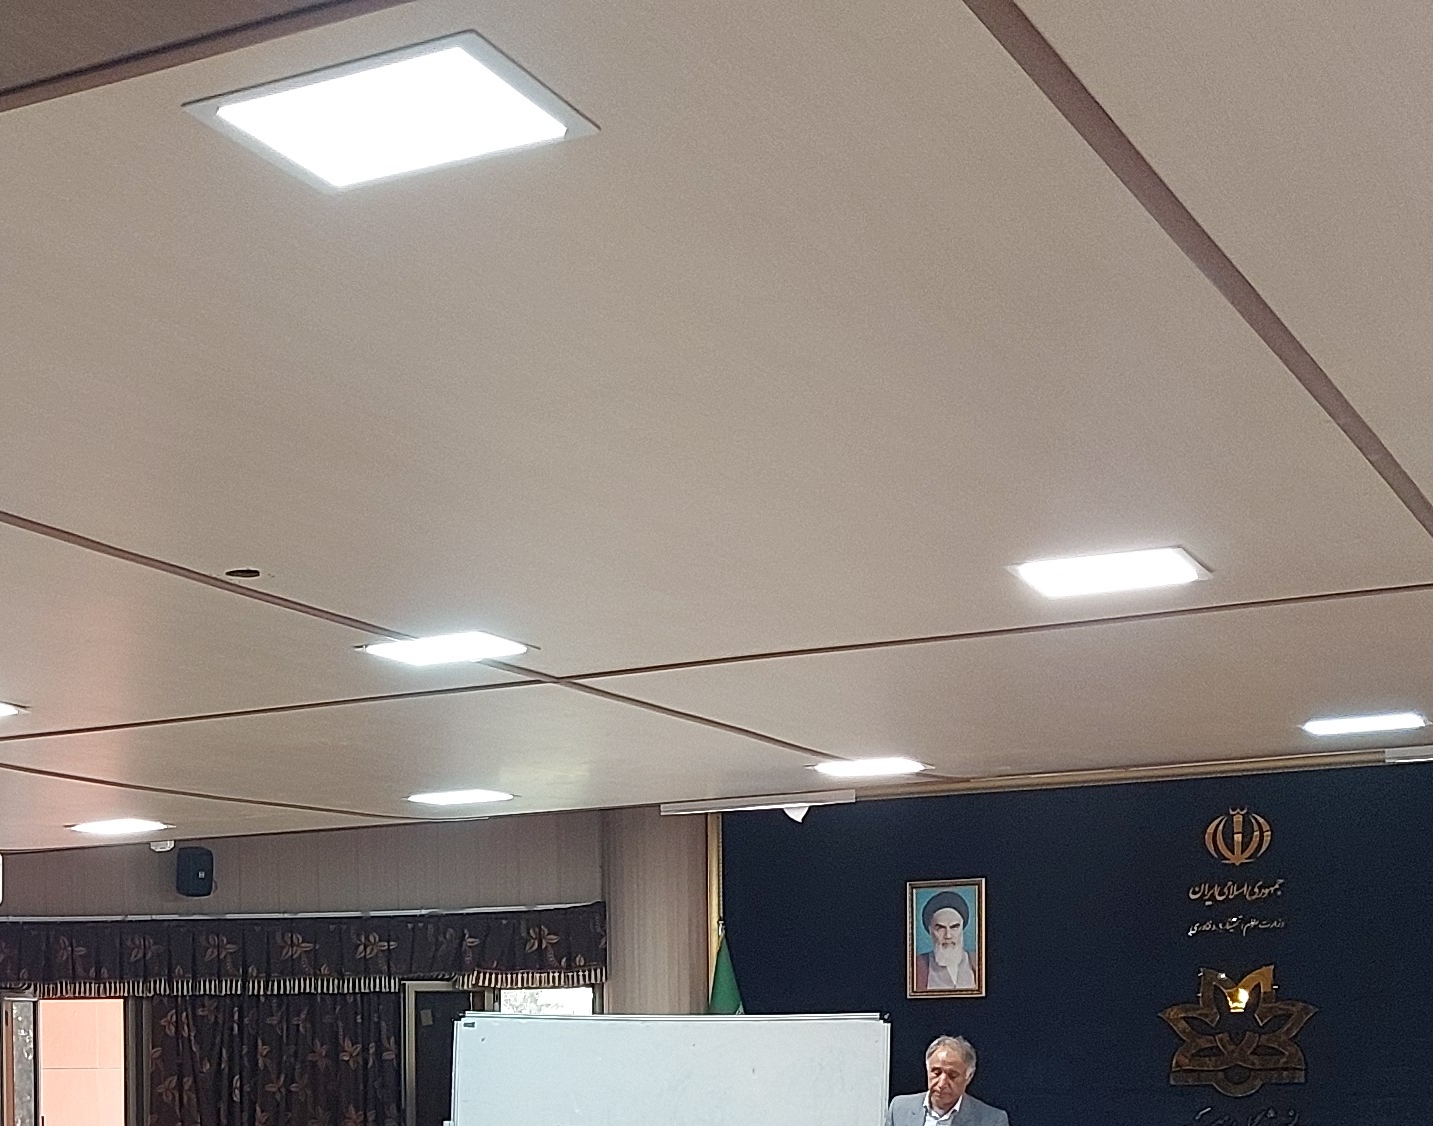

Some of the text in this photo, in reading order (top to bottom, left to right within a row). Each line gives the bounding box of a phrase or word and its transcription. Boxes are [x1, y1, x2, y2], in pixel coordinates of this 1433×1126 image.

[1188, 878, 1285, 906] جمهوری اسلامی ایران
